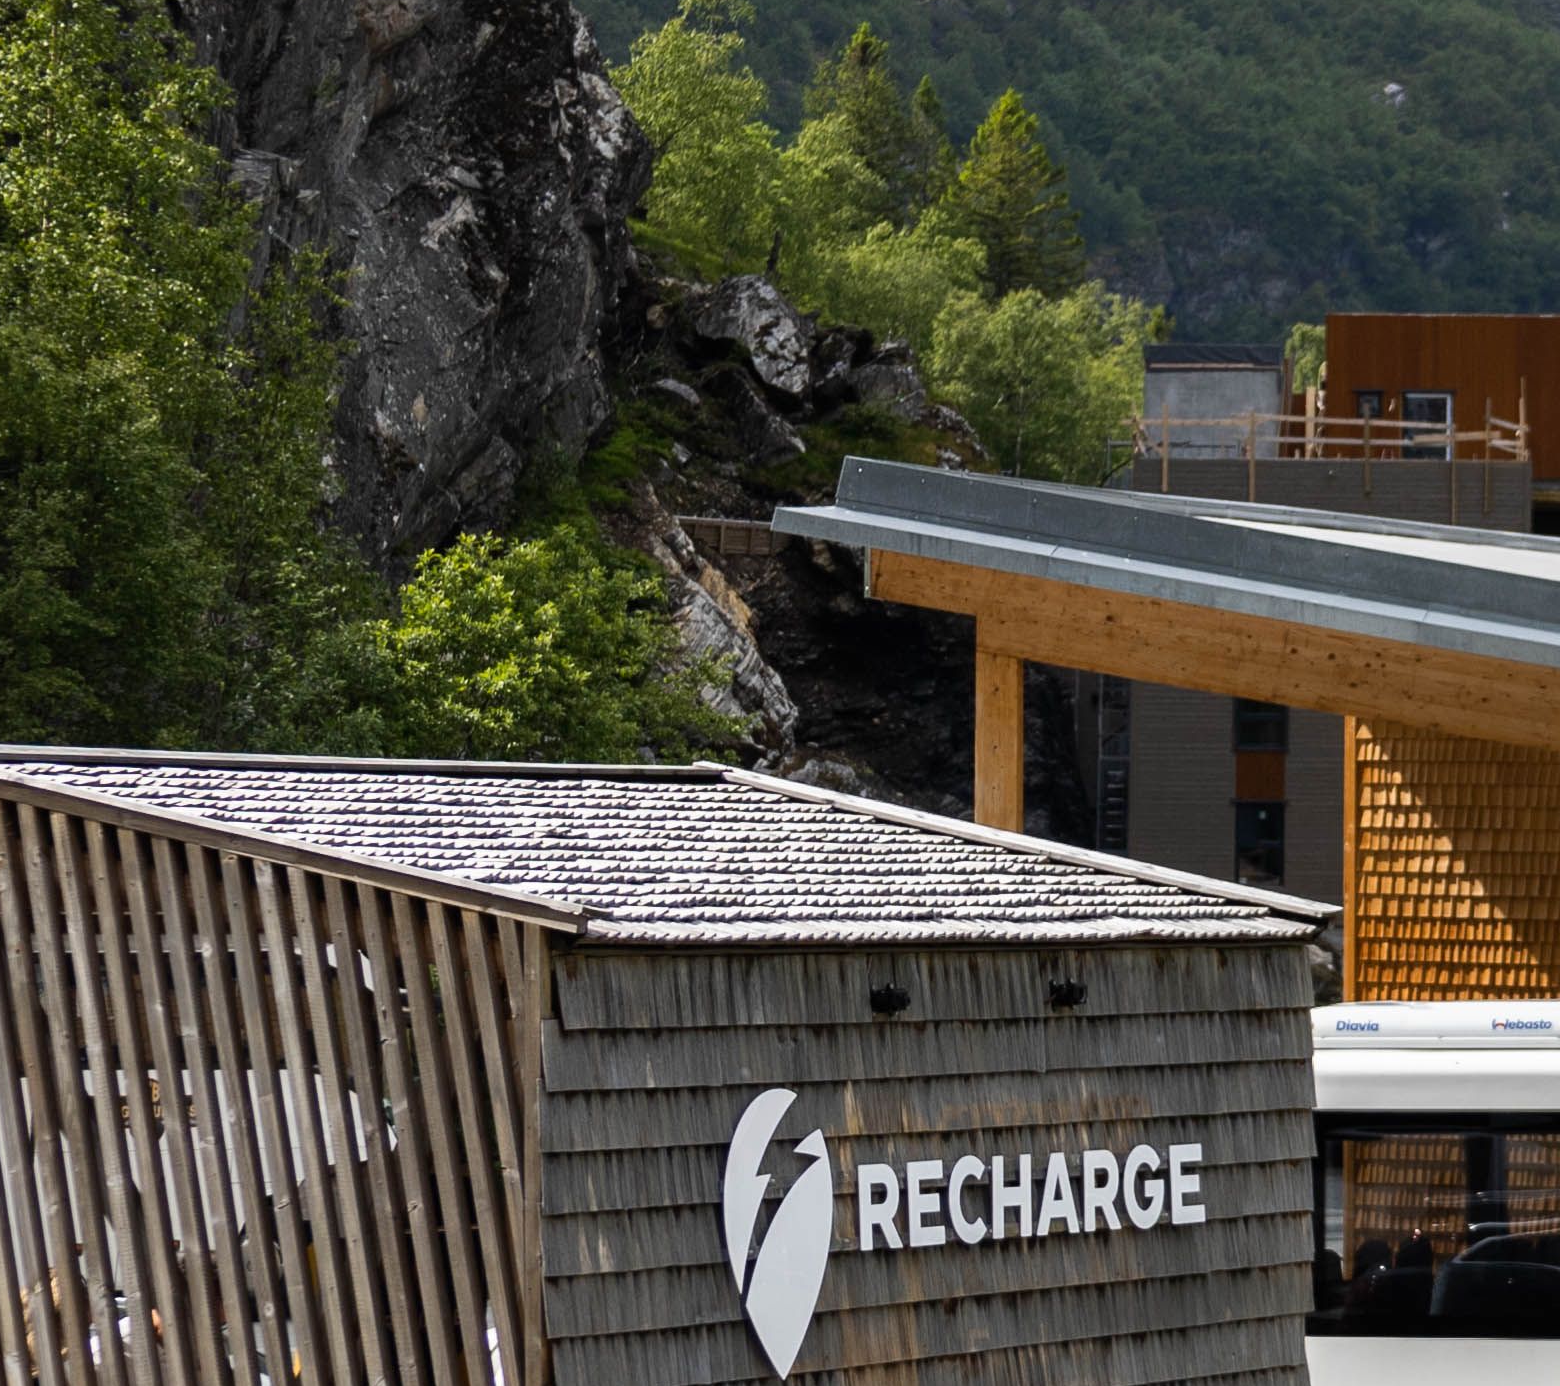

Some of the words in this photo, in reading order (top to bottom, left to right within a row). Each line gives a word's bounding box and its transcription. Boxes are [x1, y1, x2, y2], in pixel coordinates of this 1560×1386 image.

[1336, 1020, 1379, 1032] Diavia
[1492, 1018, 1552, 1030] Webasto
[857, 1143, 1206, 1251] RECHARGE
